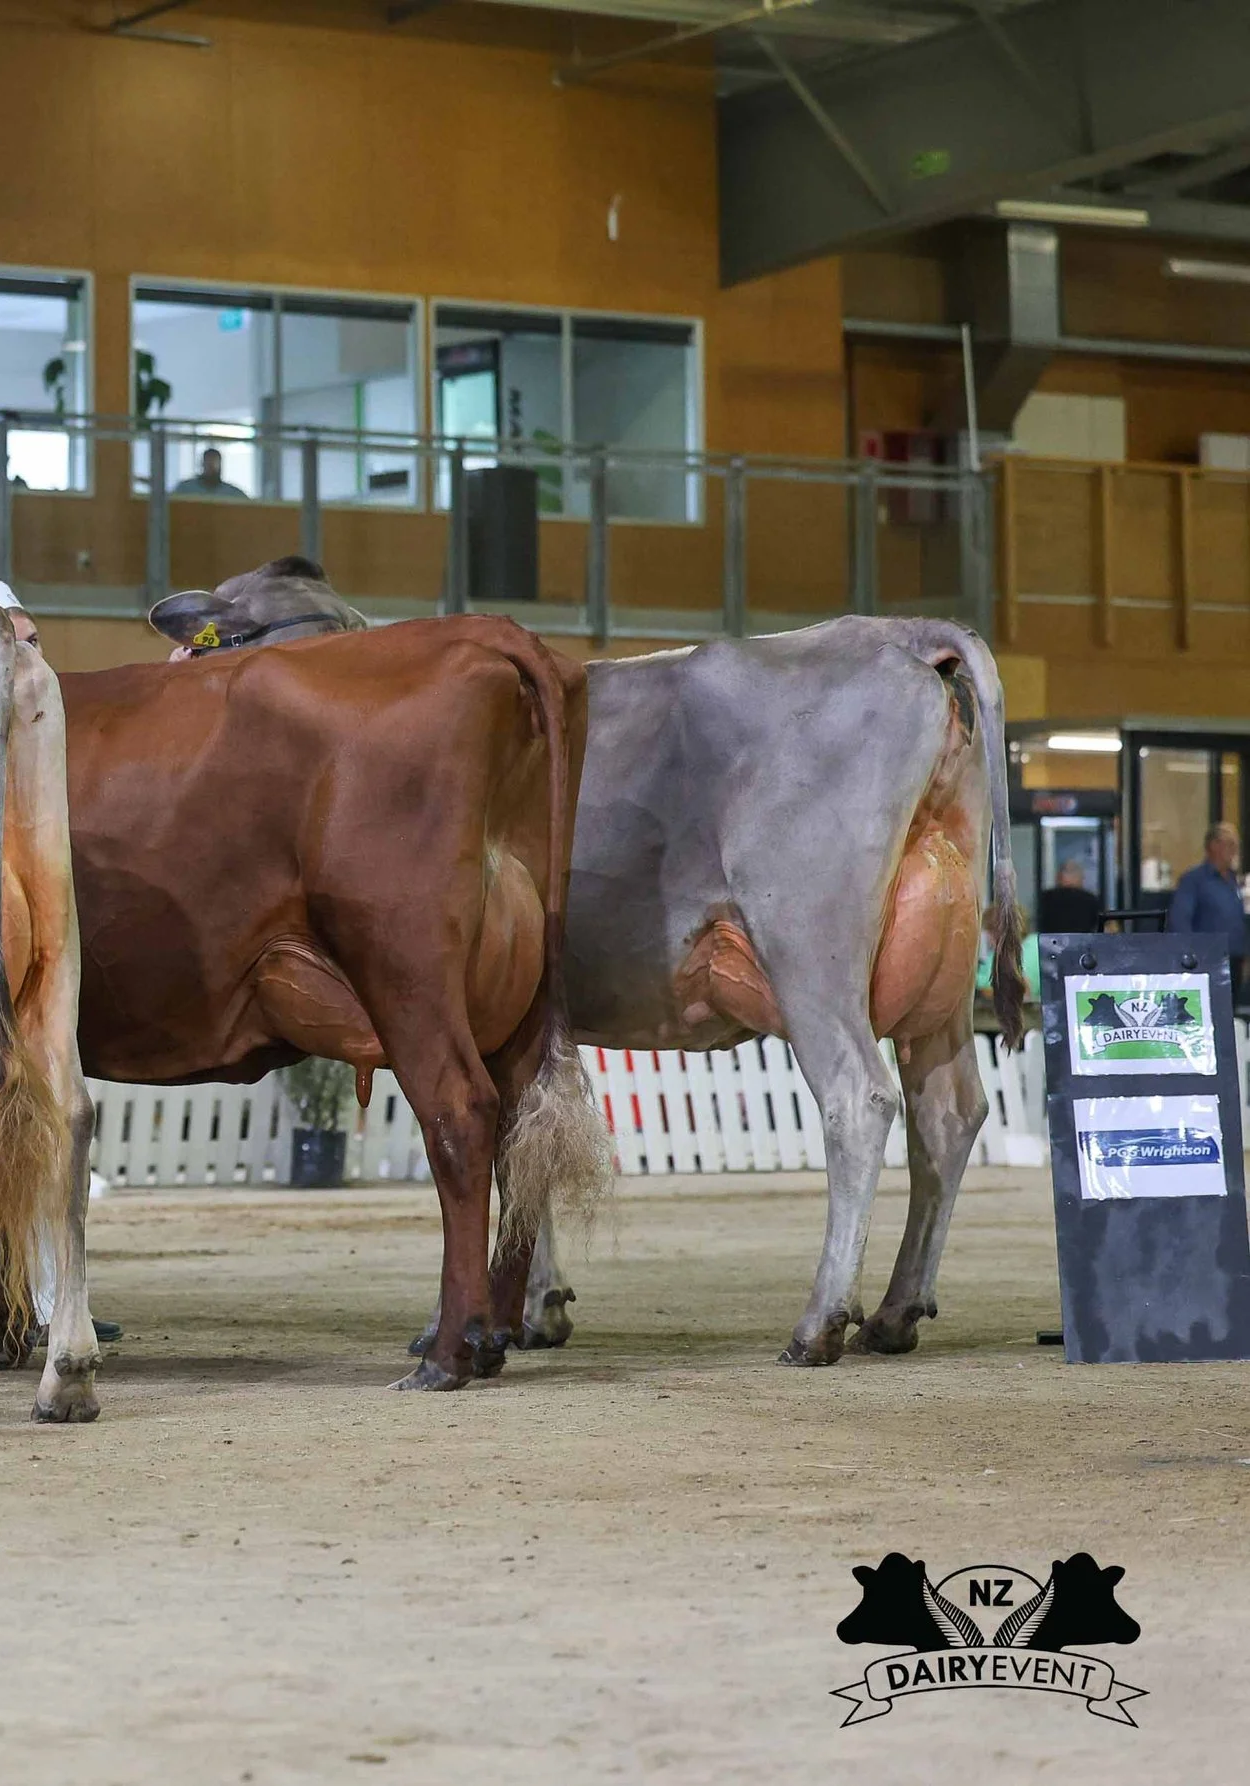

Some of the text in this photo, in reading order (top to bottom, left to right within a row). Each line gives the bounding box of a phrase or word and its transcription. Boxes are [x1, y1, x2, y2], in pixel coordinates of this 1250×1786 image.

[1131, 1002, 1148, 1013] NZ
[1108, 1145, 1210, 1160] PGG Wrightson
